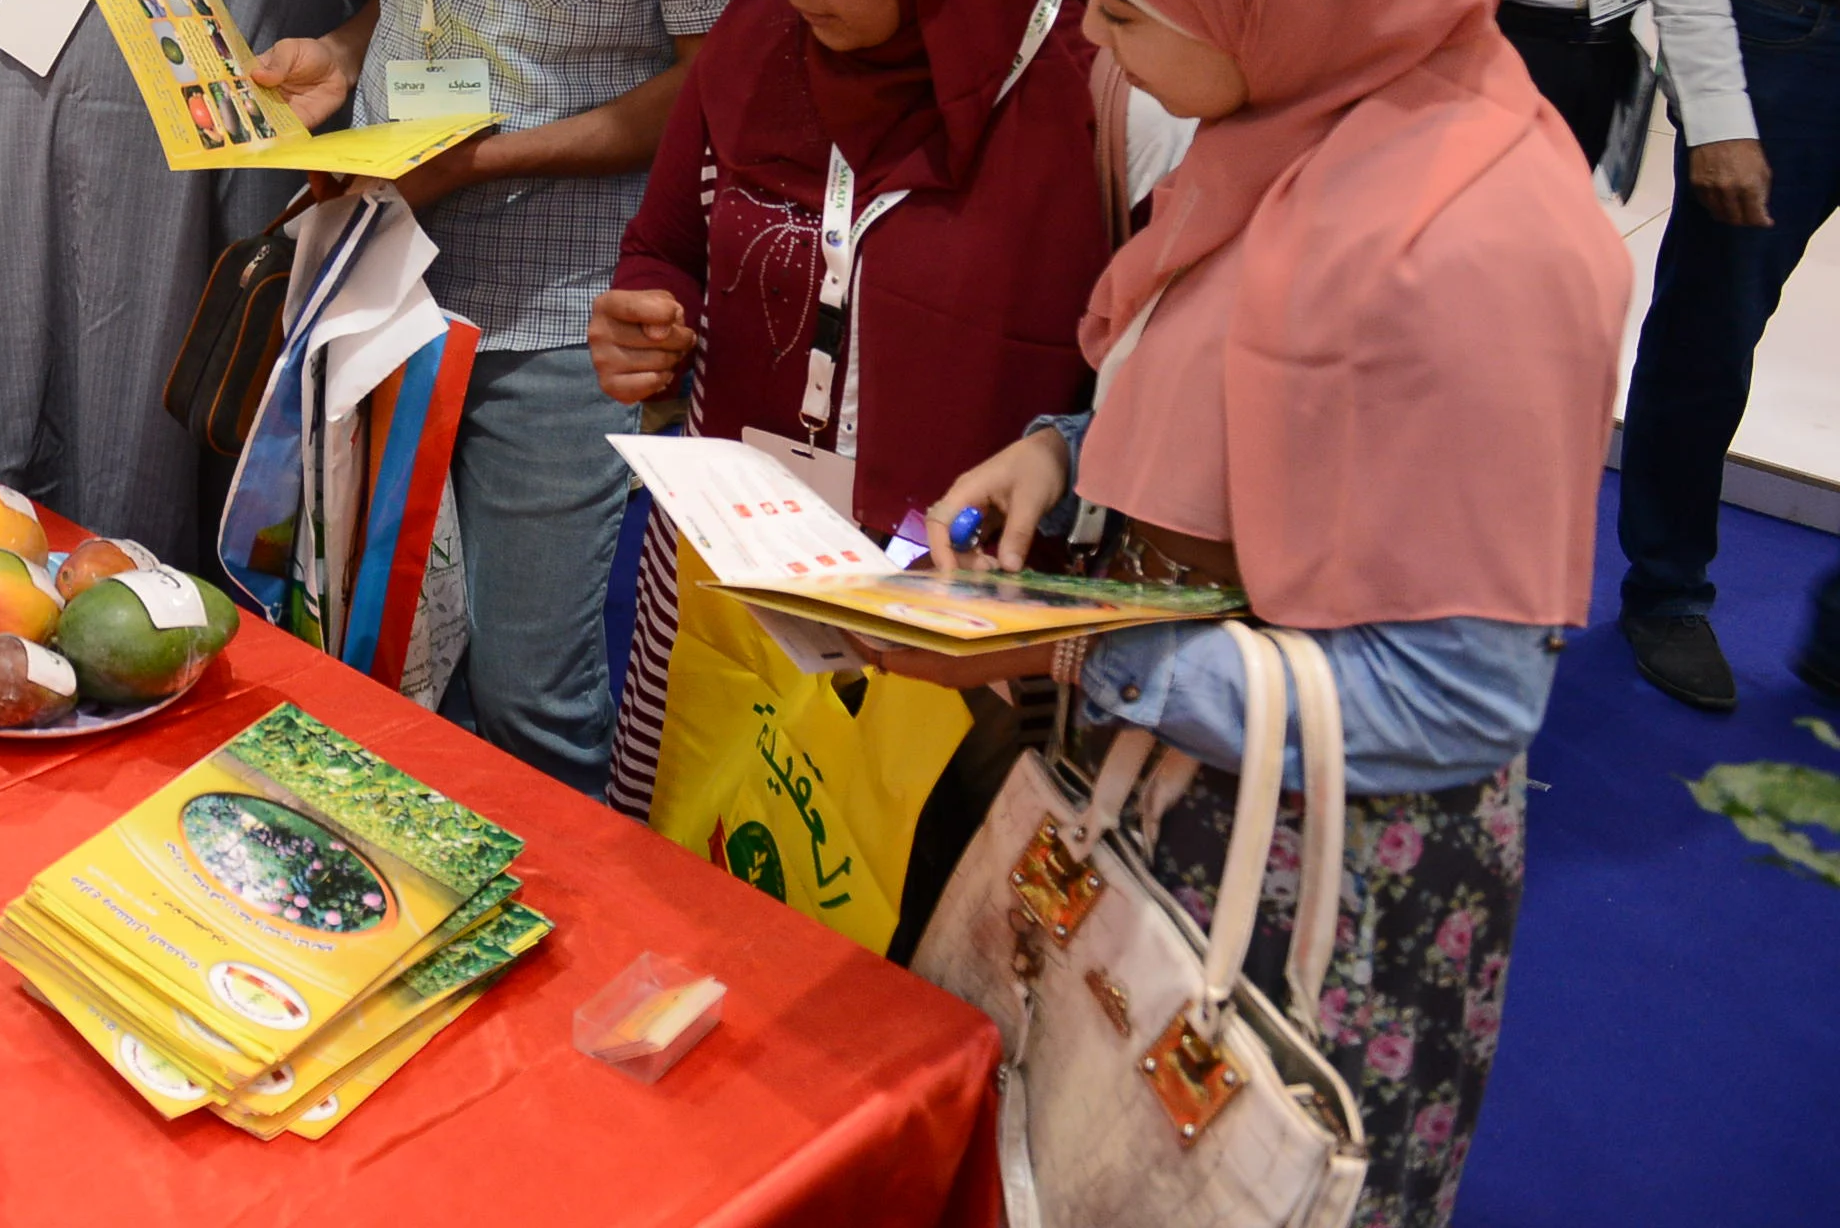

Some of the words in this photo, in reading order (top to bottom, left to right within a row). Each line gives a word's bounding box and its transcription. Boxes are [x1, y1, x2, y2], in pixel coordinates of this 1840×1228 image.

[392, 80, 425, 91] Sahara
[835, 165, 848, 208] SAKATA
[753, 701, 853, 912] العقيدة
